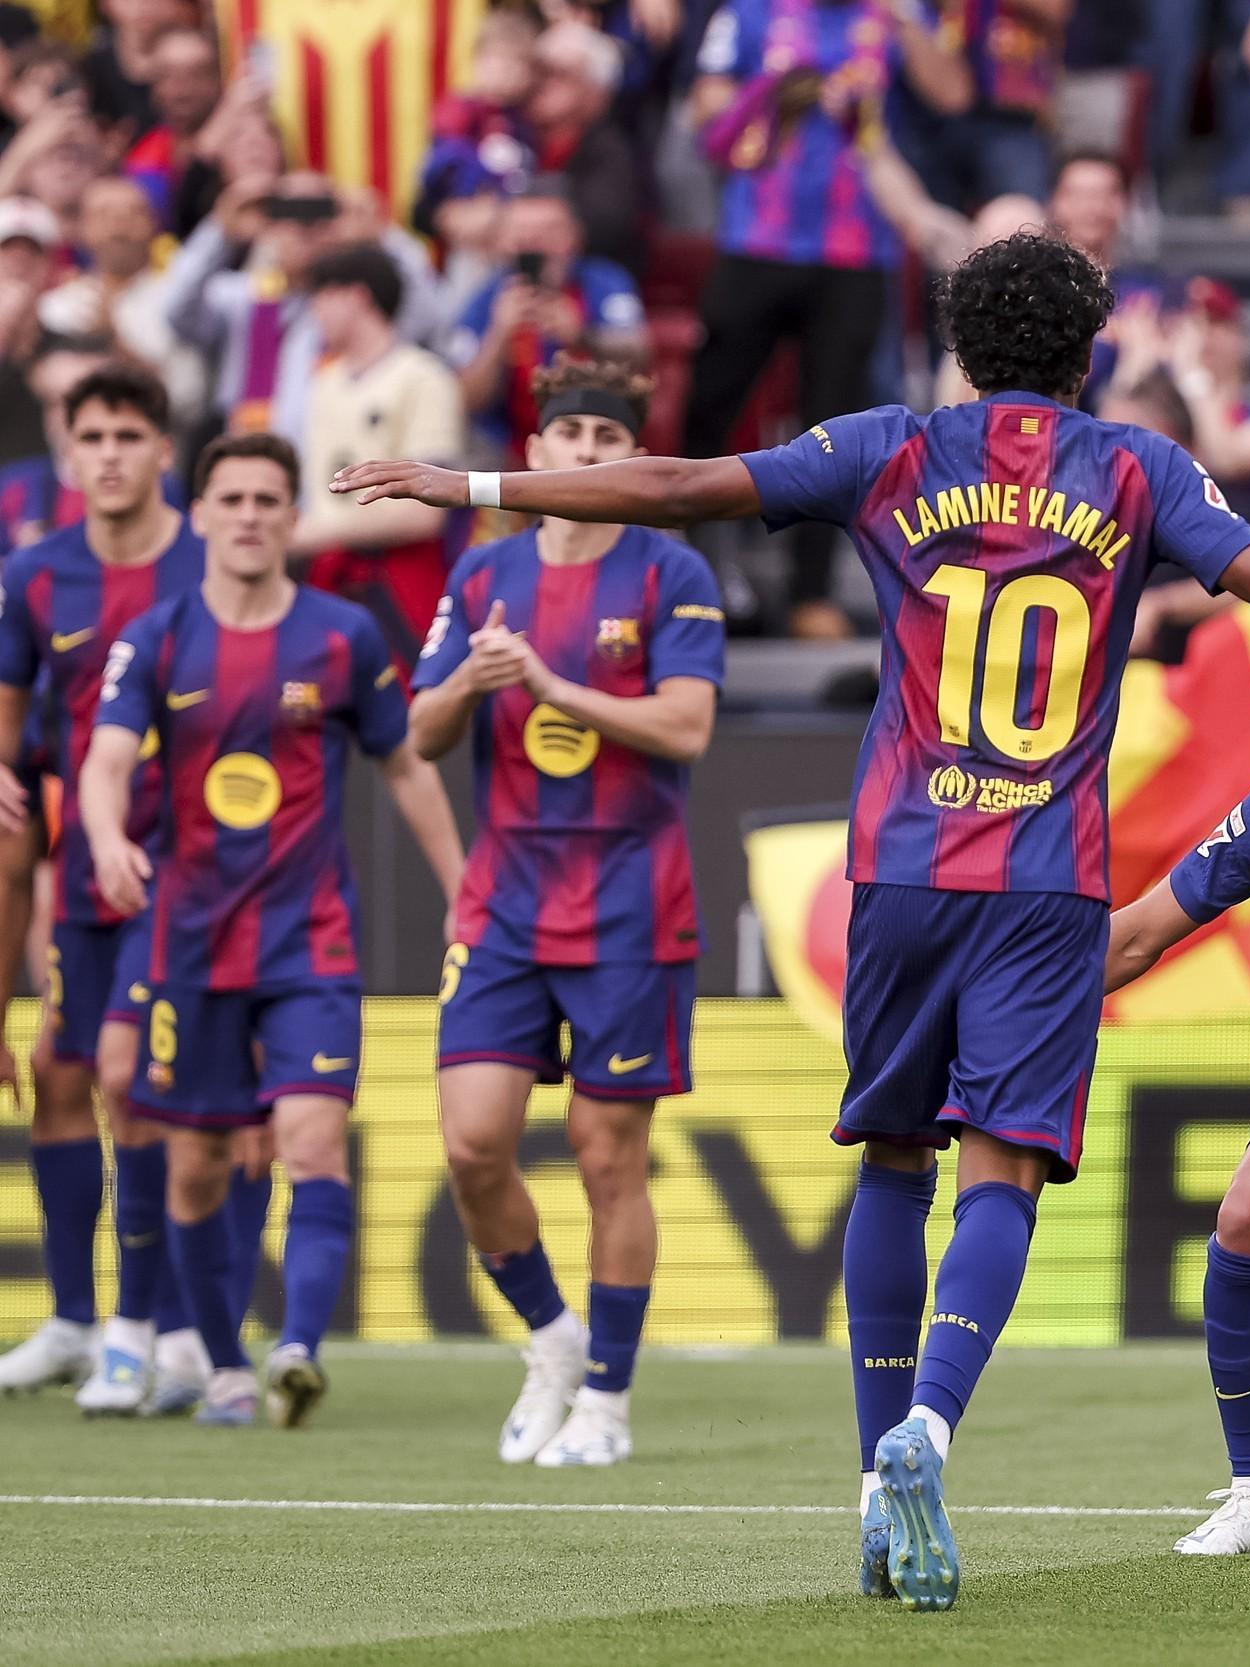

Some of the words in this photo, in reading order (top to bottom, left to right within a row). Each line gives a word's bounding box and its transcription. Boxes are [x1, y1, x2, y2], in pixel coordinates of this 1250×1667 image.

[893, 483, 1020, 547] LAMINE
[1028, 486, 1131, 571] YAMAL
[922, 564, 1090, 761] 10
[979, 778, 1052, 797] UNHCR
[149, 999, 178, 1065] 6
[864, 1357, 915, 1369] BARÇA
